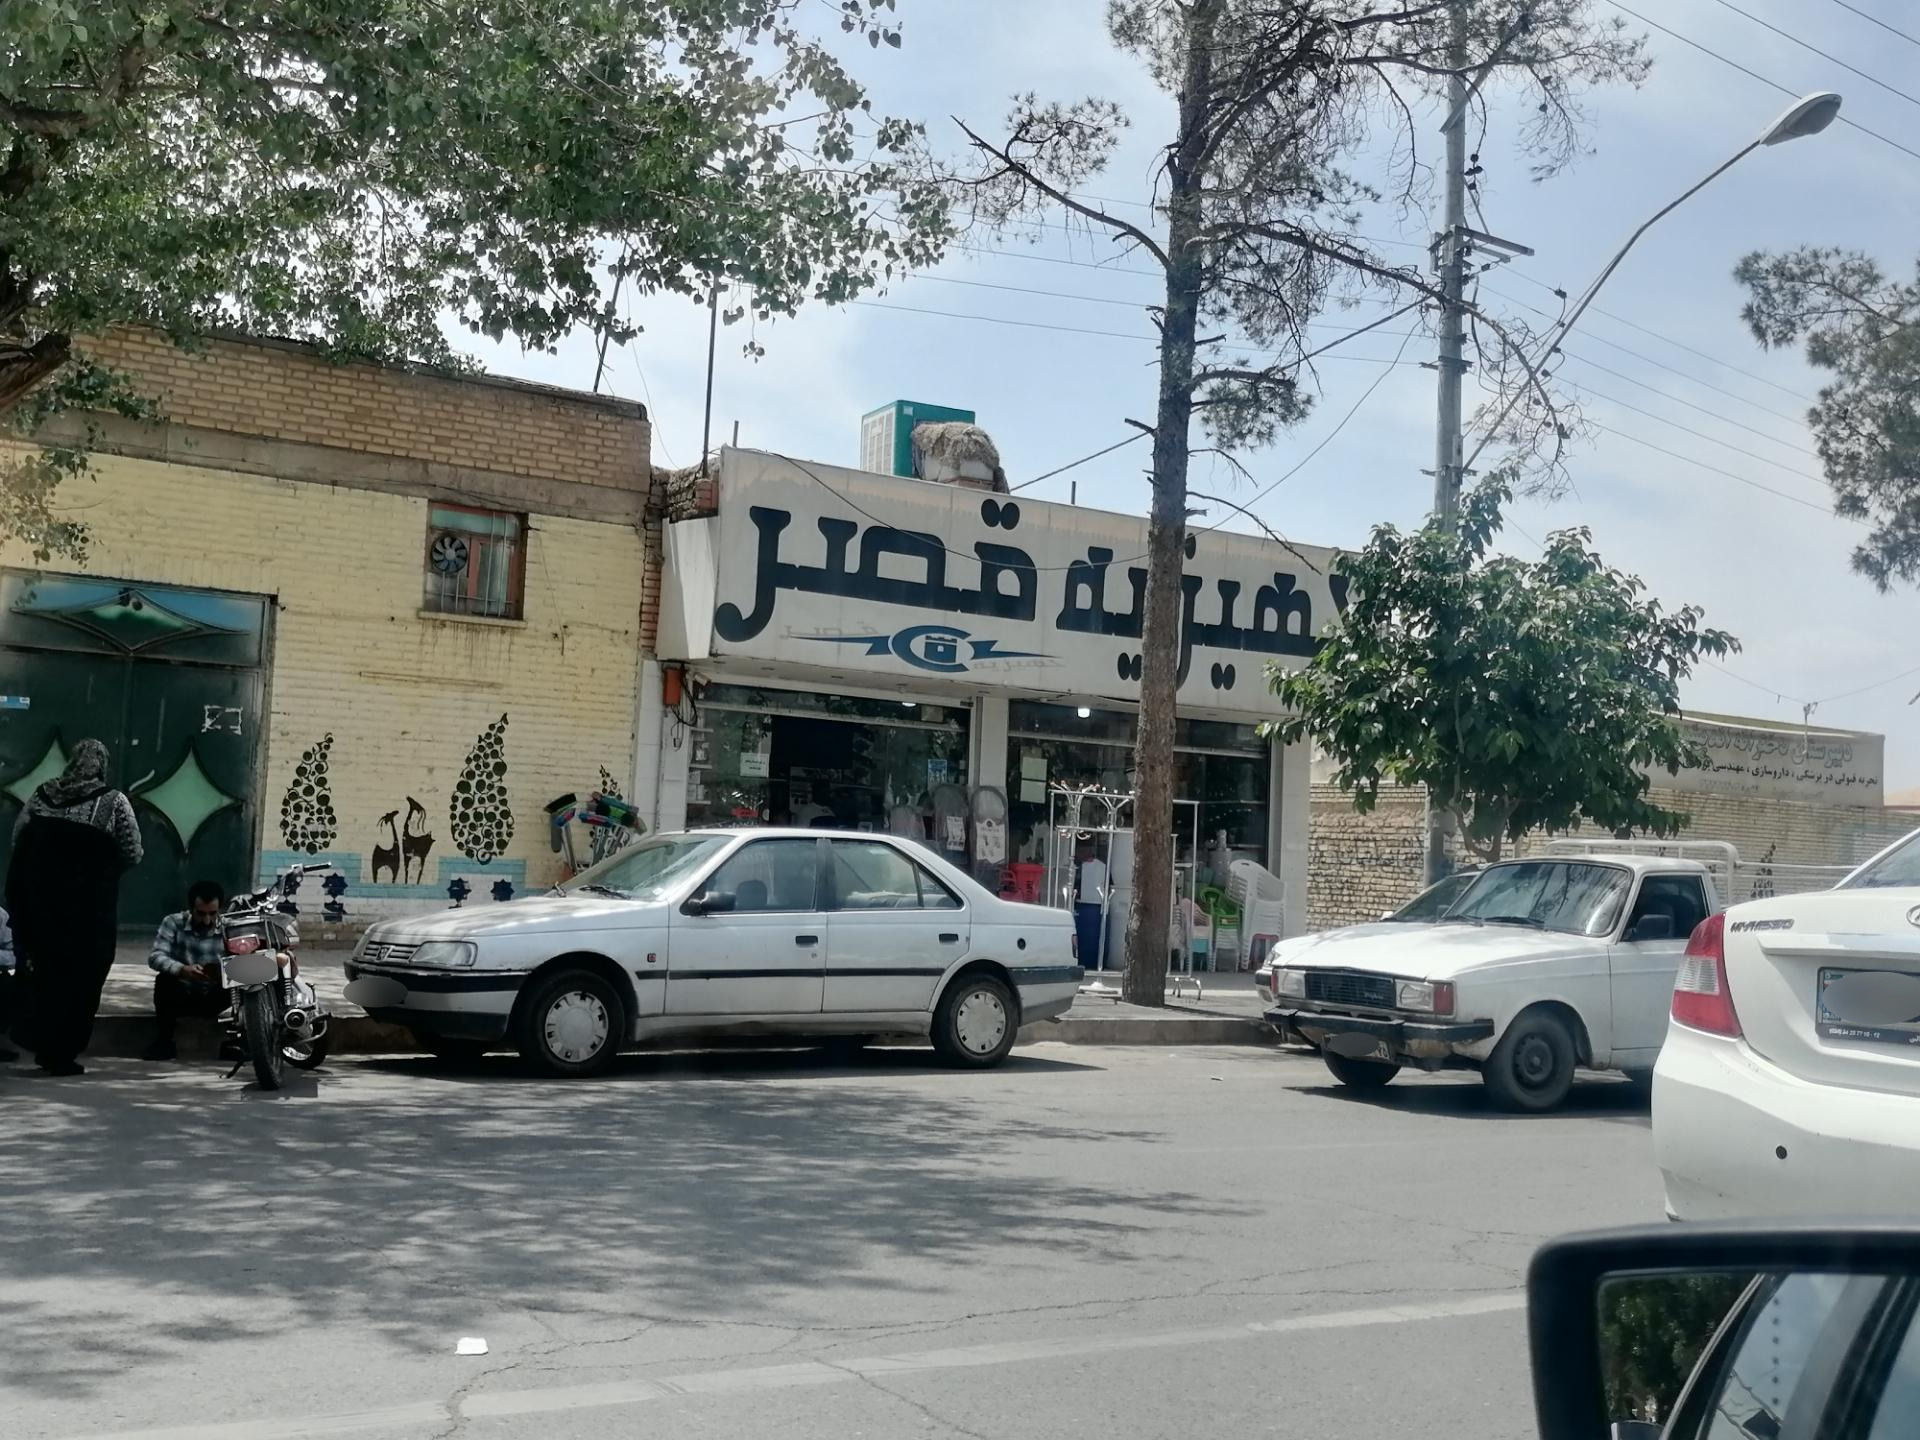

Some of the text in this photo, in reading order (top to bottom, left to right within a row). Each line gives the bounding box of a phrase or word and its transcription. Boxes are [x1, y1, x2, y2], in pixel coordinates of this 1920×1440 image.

[714, 498, 1038, 643] قصر
[1751, 765, 1789, 779] داروسازی
[1823, 773, 1833, 784] در
